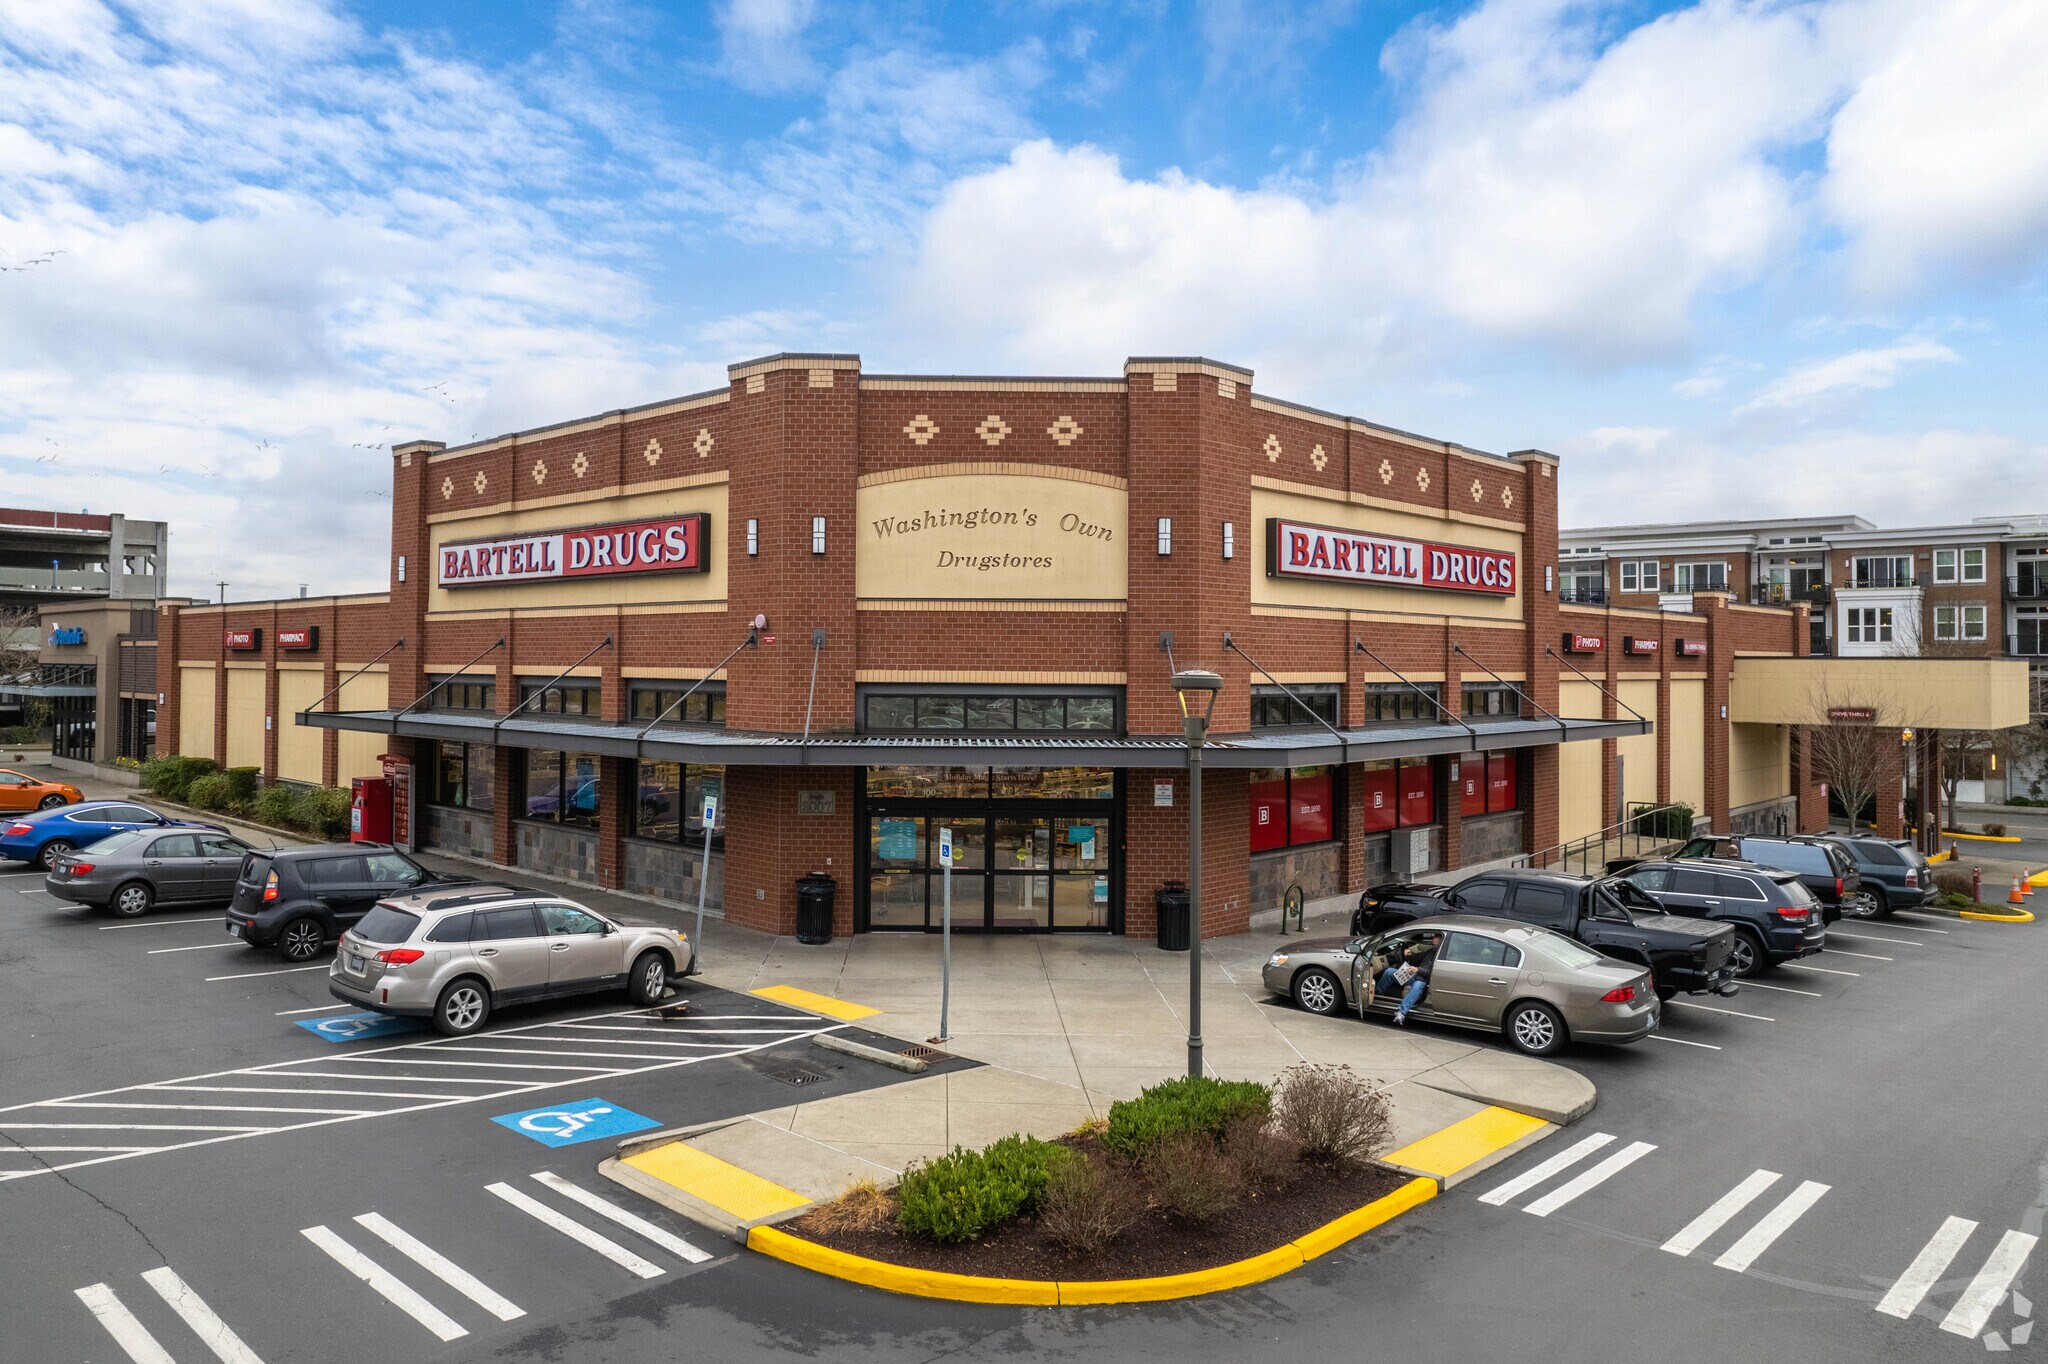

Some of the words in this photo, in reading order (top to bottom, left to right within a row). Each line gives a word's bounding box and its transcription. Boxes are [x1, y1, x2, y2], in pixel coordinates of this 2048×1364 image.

[872, 508, 1038, 540] Washington's
[1059, 512, 1113, 542] Own
[443, 541, 555, 579] BARTELL
[569, 524, 688, 569] DRUGS
[936, 550, 1053, 572] Drugstores
[1289, 531, 1418, 578] BARTELL
[1430, 551, 1512, 588] DRUGS
[233, 634, 249, 643] PHOTO
[279, 633, 305, 643] PHARMACY
[1581, 637, 1600, 648] PHOTO
[1634, 640, 1658, 650] PHARMACY
[802, 800, 832, 812] 2007
